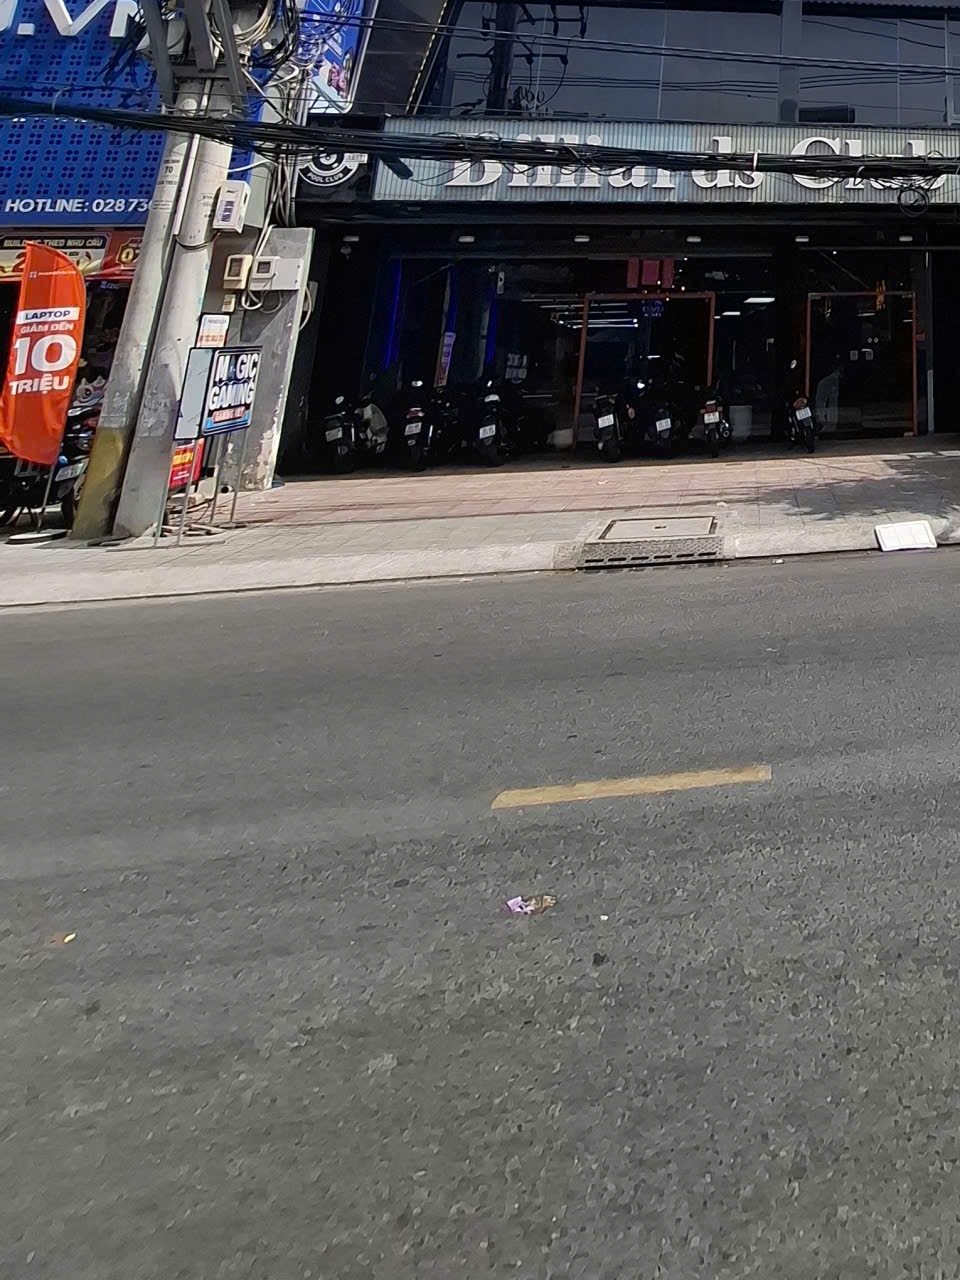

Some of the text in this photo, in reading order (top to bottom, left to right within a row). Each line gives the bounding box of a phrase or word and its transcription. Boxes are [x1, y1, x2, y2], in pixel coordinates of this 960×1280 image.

[307, 171, 344, 183] POOL CLUB
[5, 199, 89, 213] HOTLINE:
[92, 199, 153, 213] 028.73
[25, 310, 71, 320] LAPTOP
[14, 334, 77, 376] 10
[214, 353, 260, 382] MAGIC
[9, 374, 70, 396] TRIỆU
[208, 381, 255, 411] GAMING
